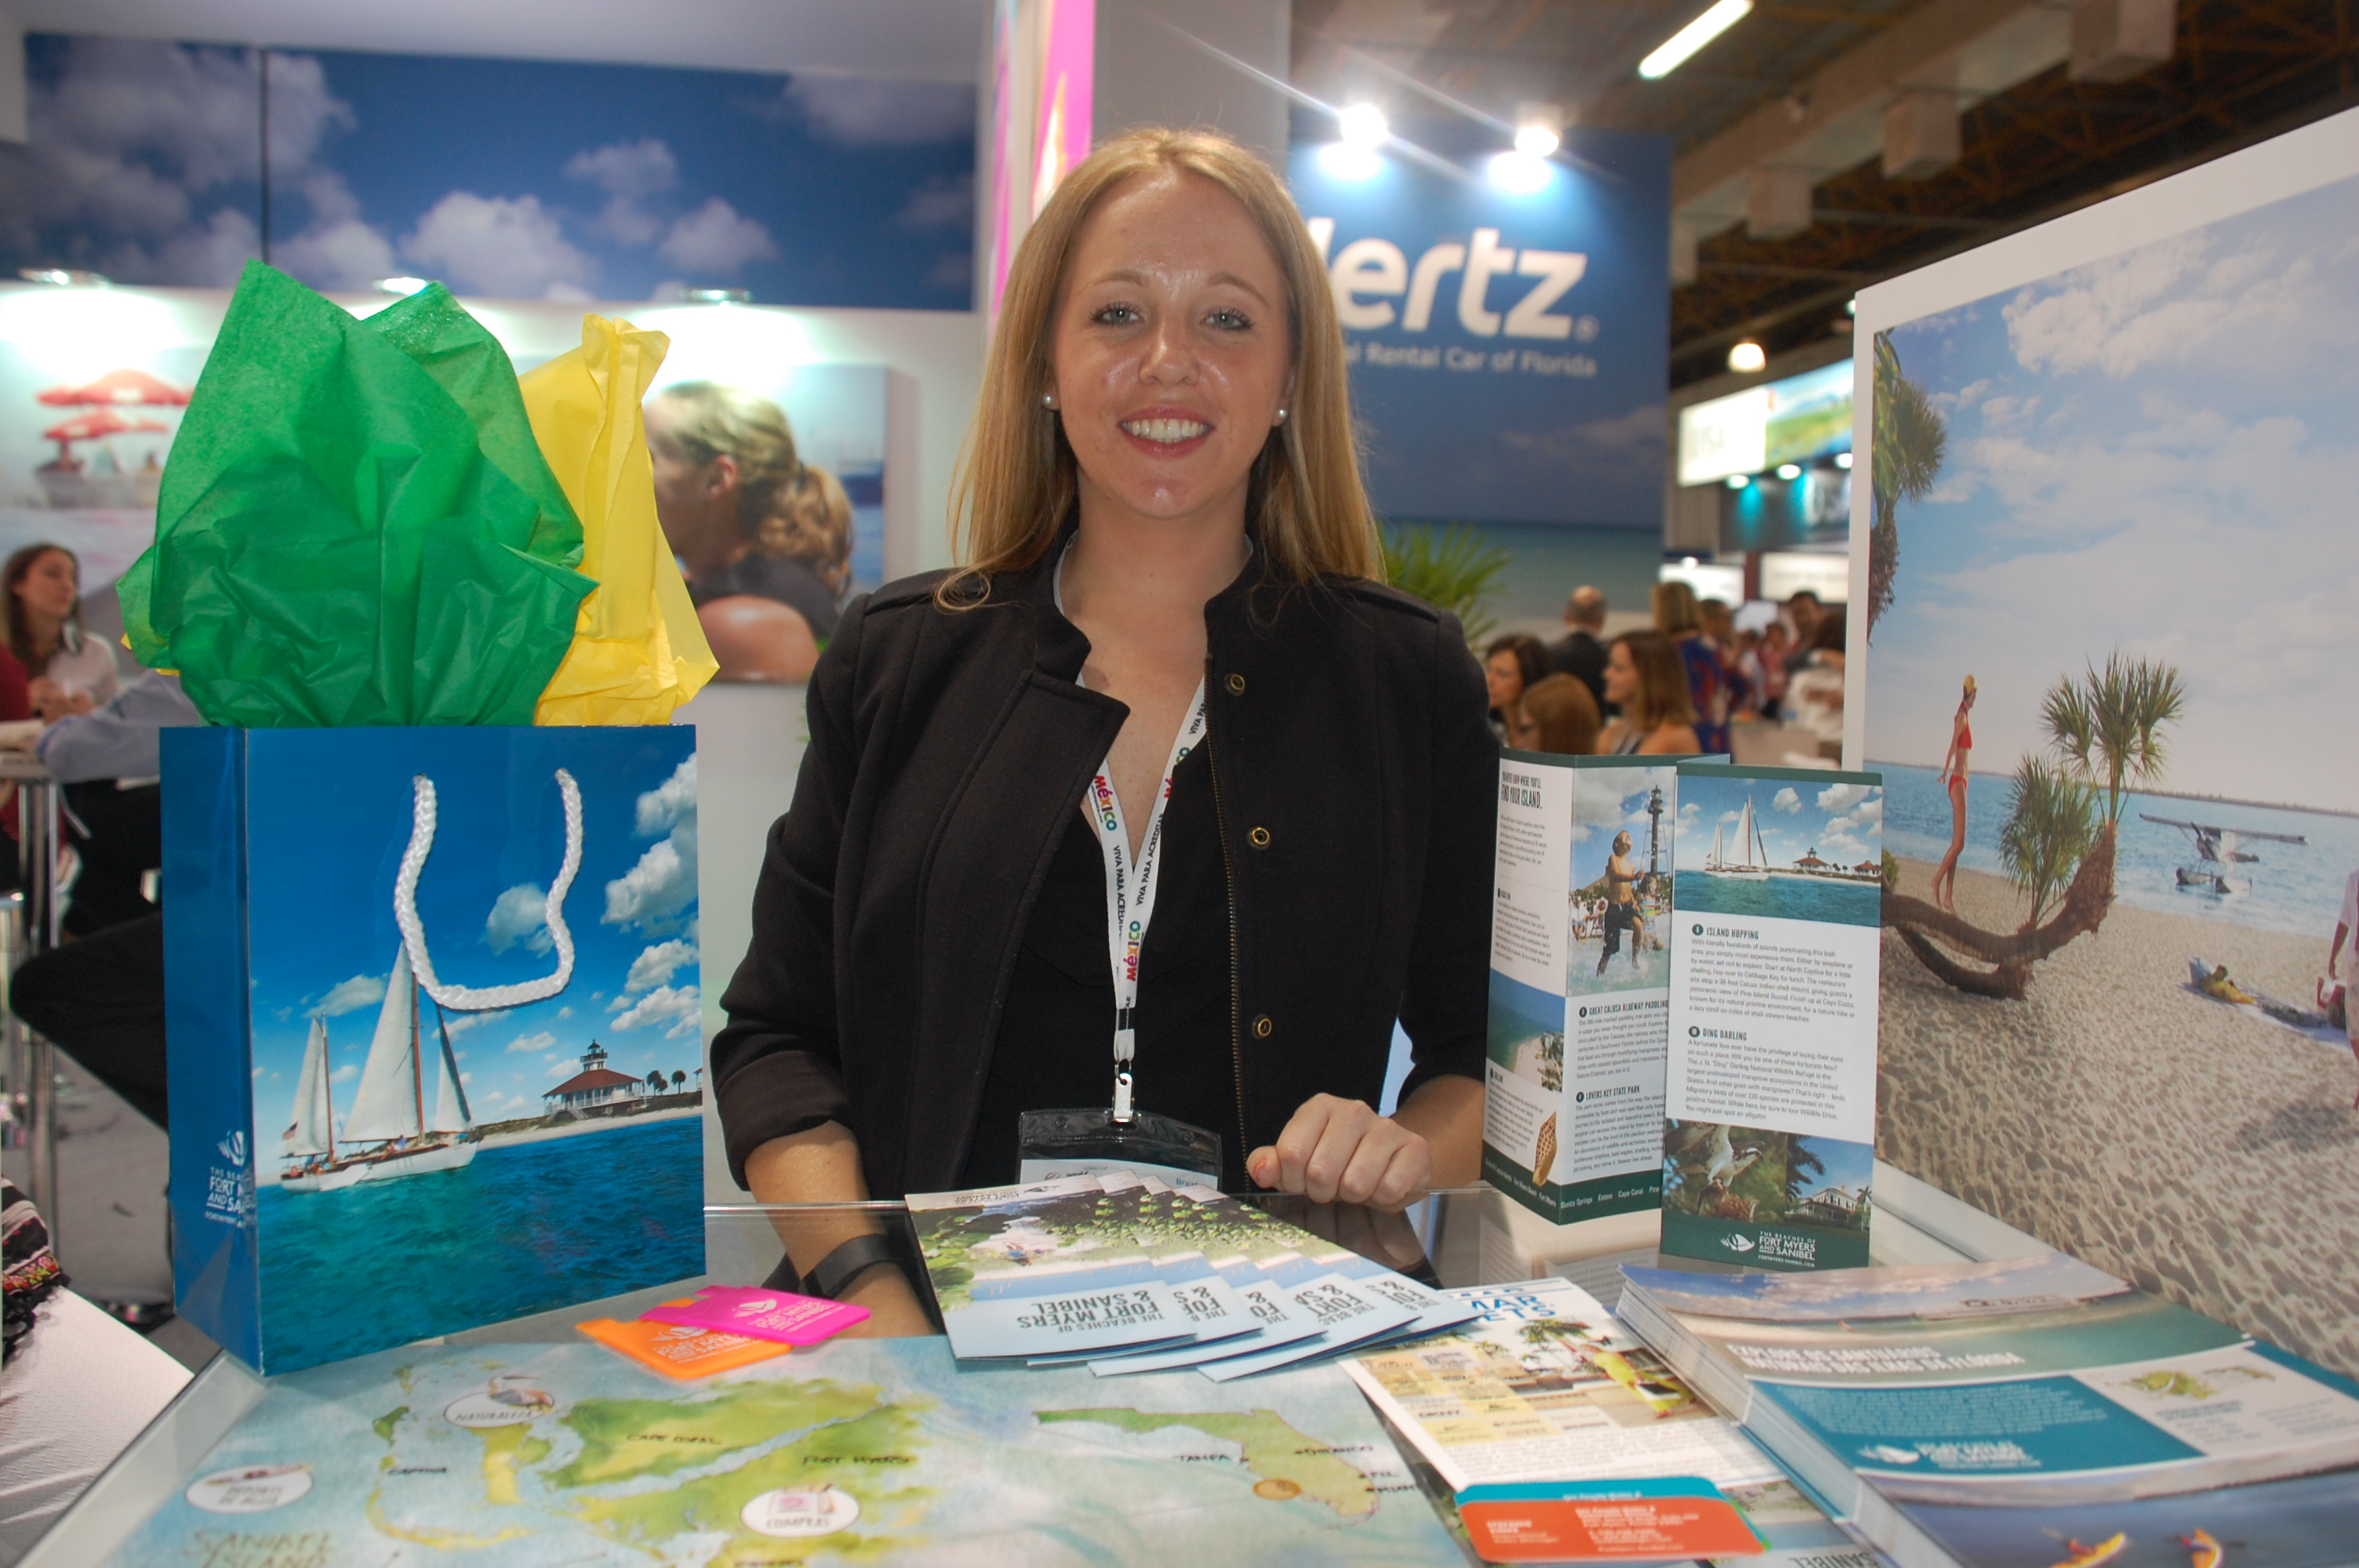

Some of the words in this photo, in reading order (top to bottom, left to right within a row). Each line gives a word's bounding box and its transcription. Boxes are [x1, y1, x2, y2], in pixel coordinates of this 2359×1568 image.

[1308, 217, 1587, 339] ertz
[1367, 343, 1440, 368] Rental
[1446, 346, 1484, 371] Car
[1494, 348, 1515, 372] of
[1521, 351, 1597, 377] Florida
[1188, 717, 1203, 735] VIVA
[1521, 789, 1542, 809] ISLAND.
[1113, 844, 1122, 867] VIVA
[1116, 868, 1125, 891] PARA
[1135, 884, 1147, 906] VIVA
[1141, 860, 1153, 884] PARA
[1707, 927, 1729, 937] ISLAND
[1732, 930, 1759, 939] HOPPING
[1750, 953, 1779, 961] experience
[1779, 946, 1812, 956] punctuating
[1590, 1006, 1603, 1015] GREAT
[1605, 1004, 1621, 1014] CALUSA
[1623, 1003, 1644, 1011] BLUEWAY
[1703, 1028, 1717, 1038] DING
[1721, 1030, 1747, 1041] DARLING
[1730, 1062, 1749, 1071] Darling
[1795, 1069, 1815, 1078] Refuge
[1587, 1090, 1602, 1100] LOVERS
[1613, 1087, 1627, 1096] STATE
[1628, 1085, 1640, 1094] PARK
[1745, 1111, 1767, 1120] alligator.
[209, 1176, 235, 1196] FORT
[208, 1192, 227, 1205] AND
[1619, 1190, 1630, 1199] Cape
[1631, 1188, 1643, 1196] Coral
[1576, 1197, 1593, 1207] Springs
[1759, 1236, 1782, 1247] FORT
[1784, 1240, 1816, 1252] MYERS
[1775, 1233, 1804, 1242] BEACHES
[1776, 1247, 1815, 1260] SANIBEL
[1132, 1290, 1151, 1301] &
[1190, 1287, 1211, 1299] &
[1318, 1284, 1344, 1294] &
[1245, 1290, 1267, 1304] &
[1030, 1293, 1125, 1316] SANIBEL
[1104, 1301, 1162, 1319] FORT
[1182, 1297, 1227, 1316] FOR
[1249, 1301, 1281, 1318] FO
[1306, 1292, 1364, 1318] FORT
[1353, 1302, 1377, 1316] THE
[1016, 1308, 1096, 1329] MYERS
[1141, 1312, 1166, 1323] THE
[1205, 1307, 1230, 1320] THE
[1263, 1312, 1290, 1326] THE
[1318, 1311, 1353, 1327] BEAC
[1057, 1324, 1073, 1334] OF
[1078, 1317, 1137, 1331] BEACHES
[803, 1457, 843, 1465] FORT
[853, 1456, 911, 1465] MYERS
[1179, 1454, 1232, 1463] TAMPA
